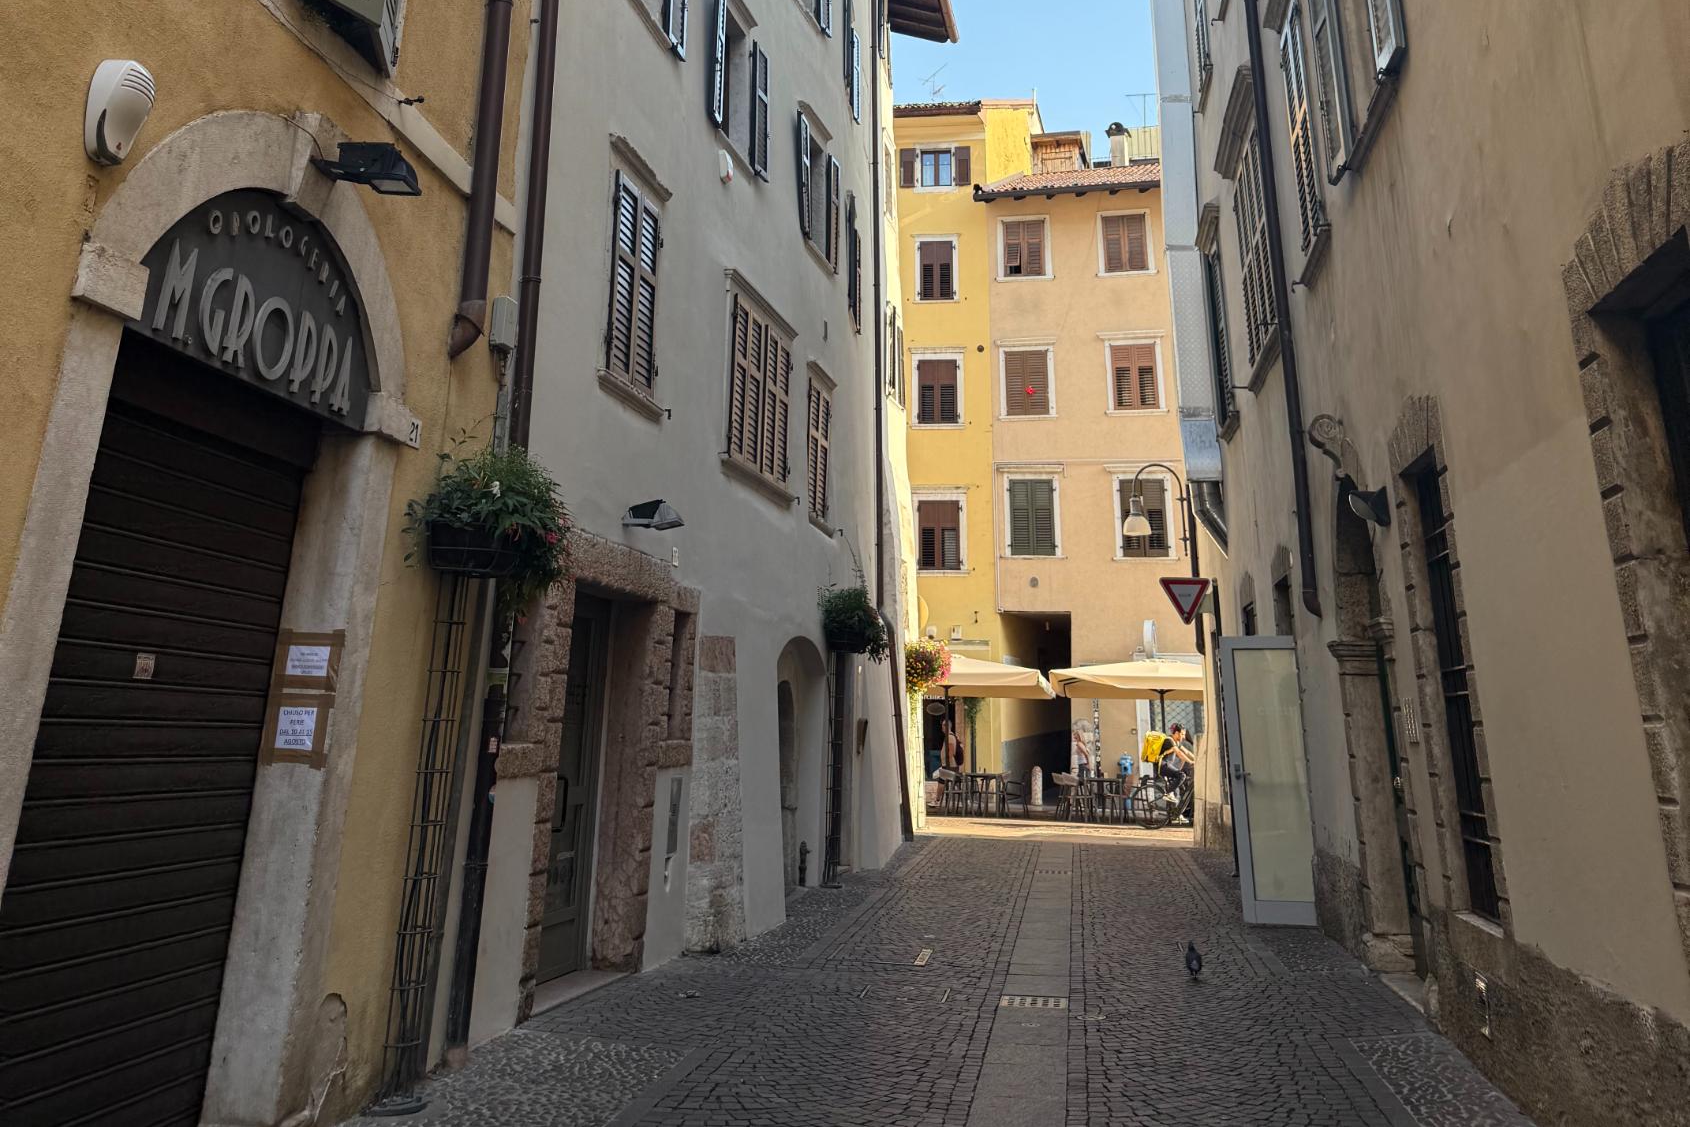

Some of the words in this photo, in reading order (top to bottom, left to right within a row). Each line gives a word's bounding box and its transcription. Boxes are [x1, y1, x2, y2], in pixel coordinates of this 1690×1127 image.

[209, 210, 347, 317] OROLOGERIA
[200, 267, 353, 416] GROPPA
[408, 421, 420, 444] 21
[283, 738, 306, 746] AGOSTO
